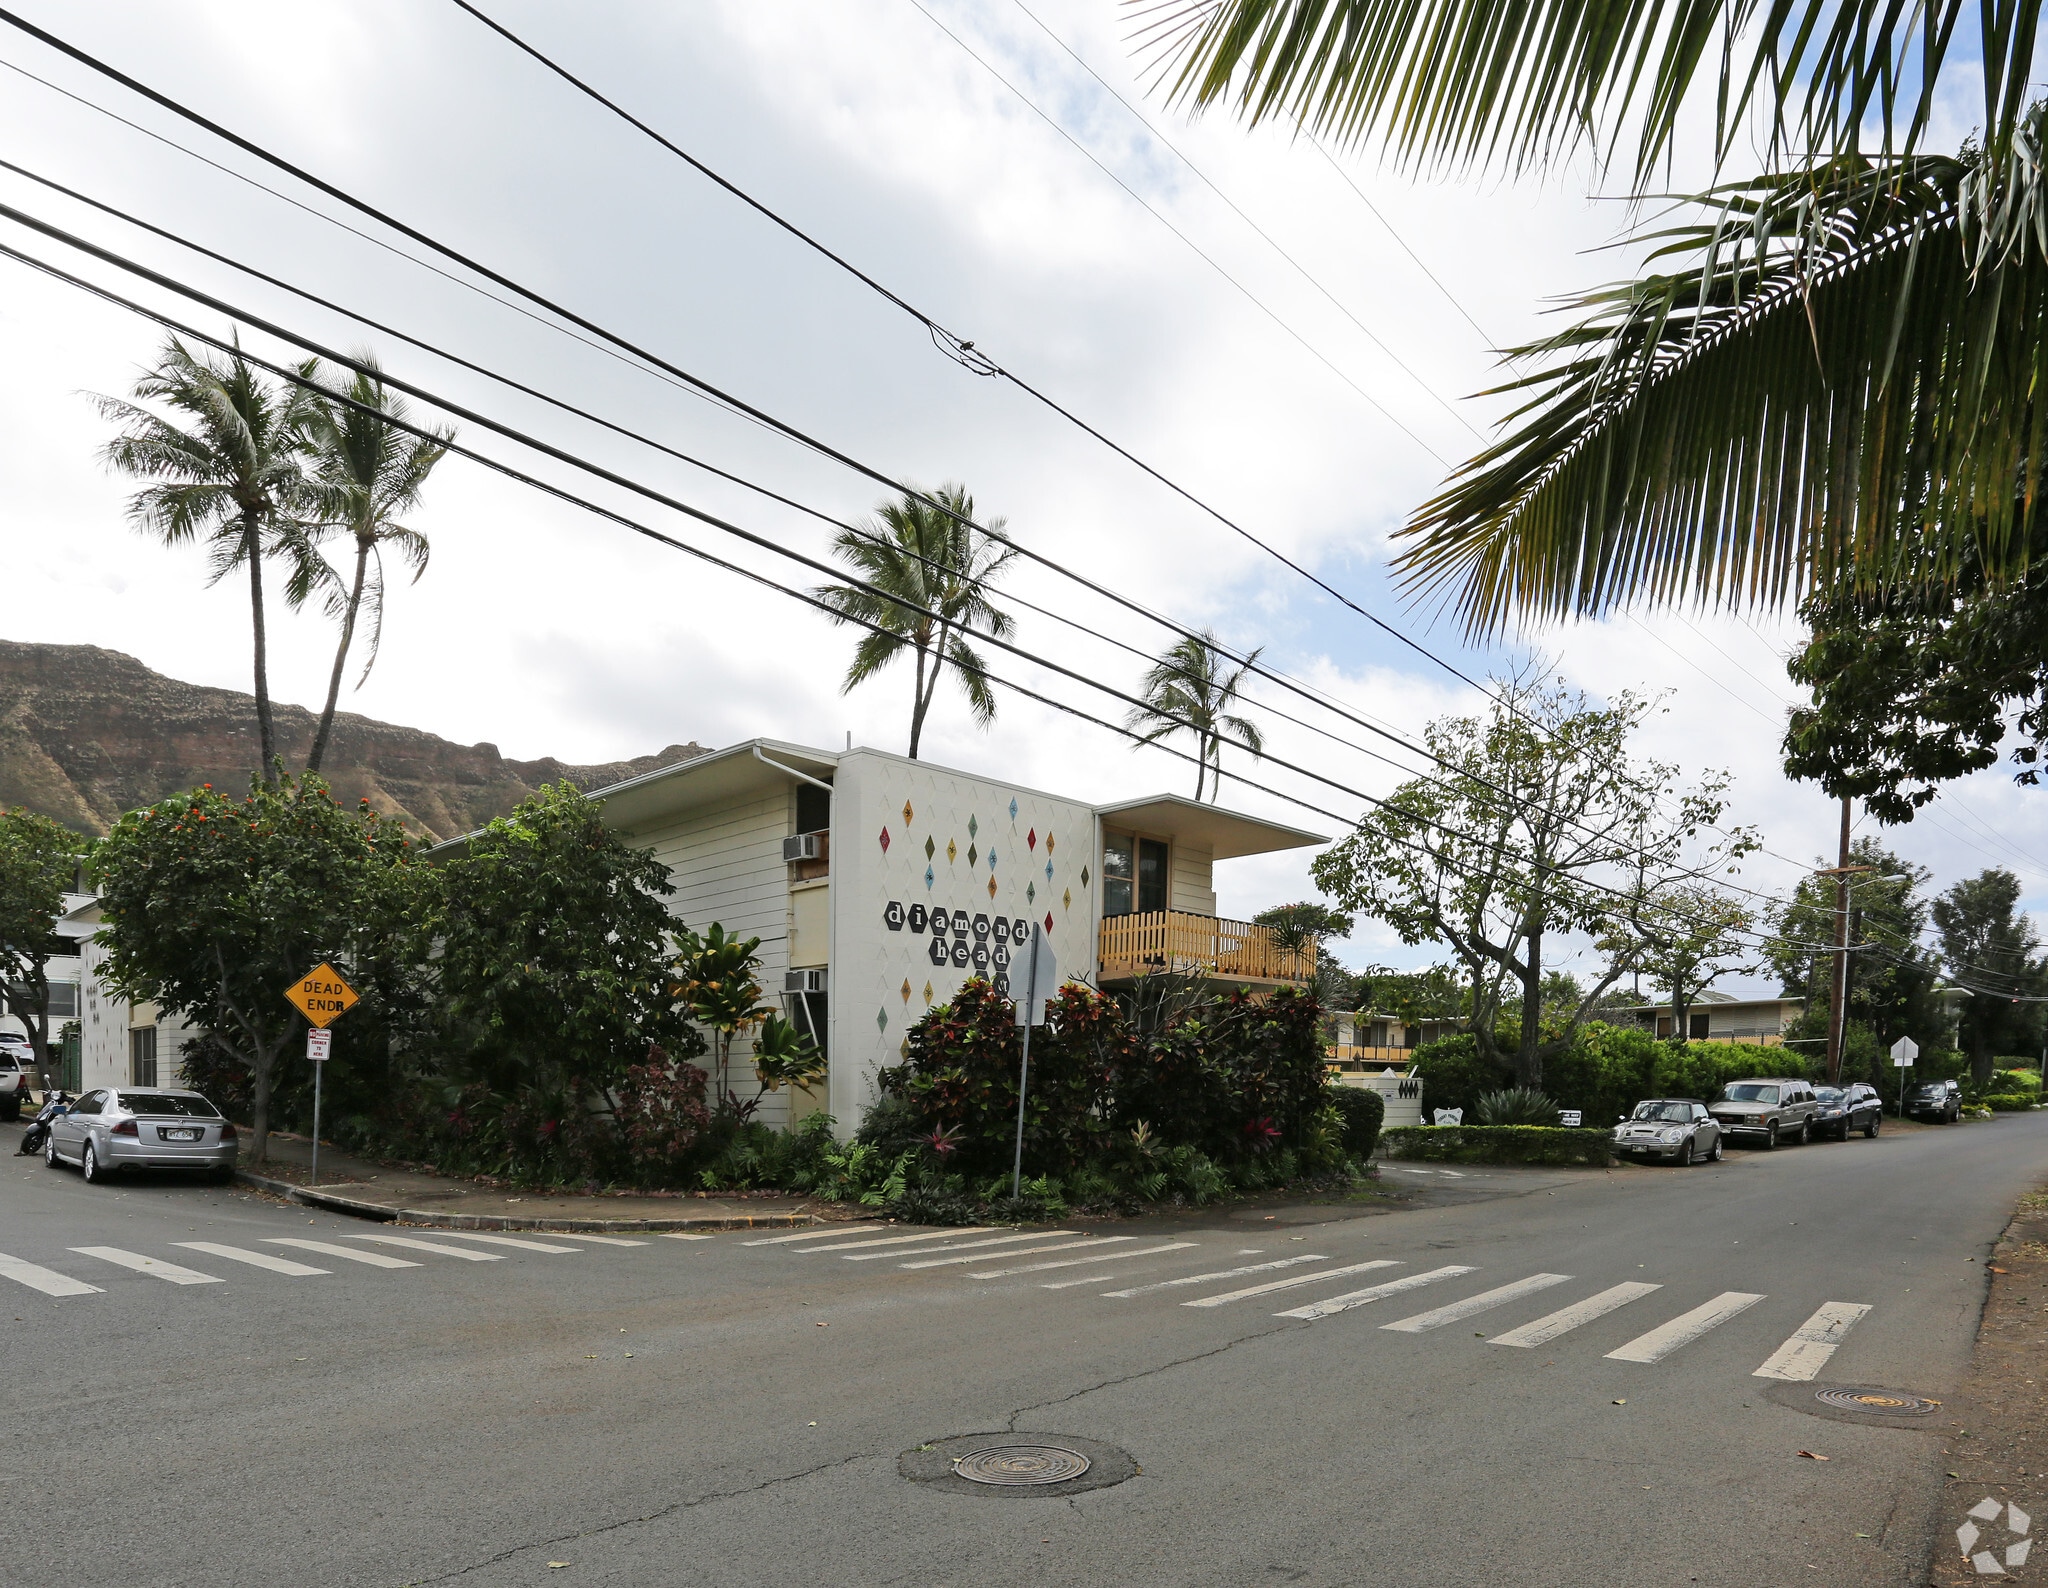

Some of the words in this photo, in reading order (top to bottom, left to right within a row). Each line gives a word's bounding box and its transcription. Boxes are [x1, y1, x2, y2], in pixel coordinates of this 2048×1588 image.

[888, 904, 1027, 940] diamond
[936, 940, 1007, 965] head
[304, 982, 343, 995] DEAD
